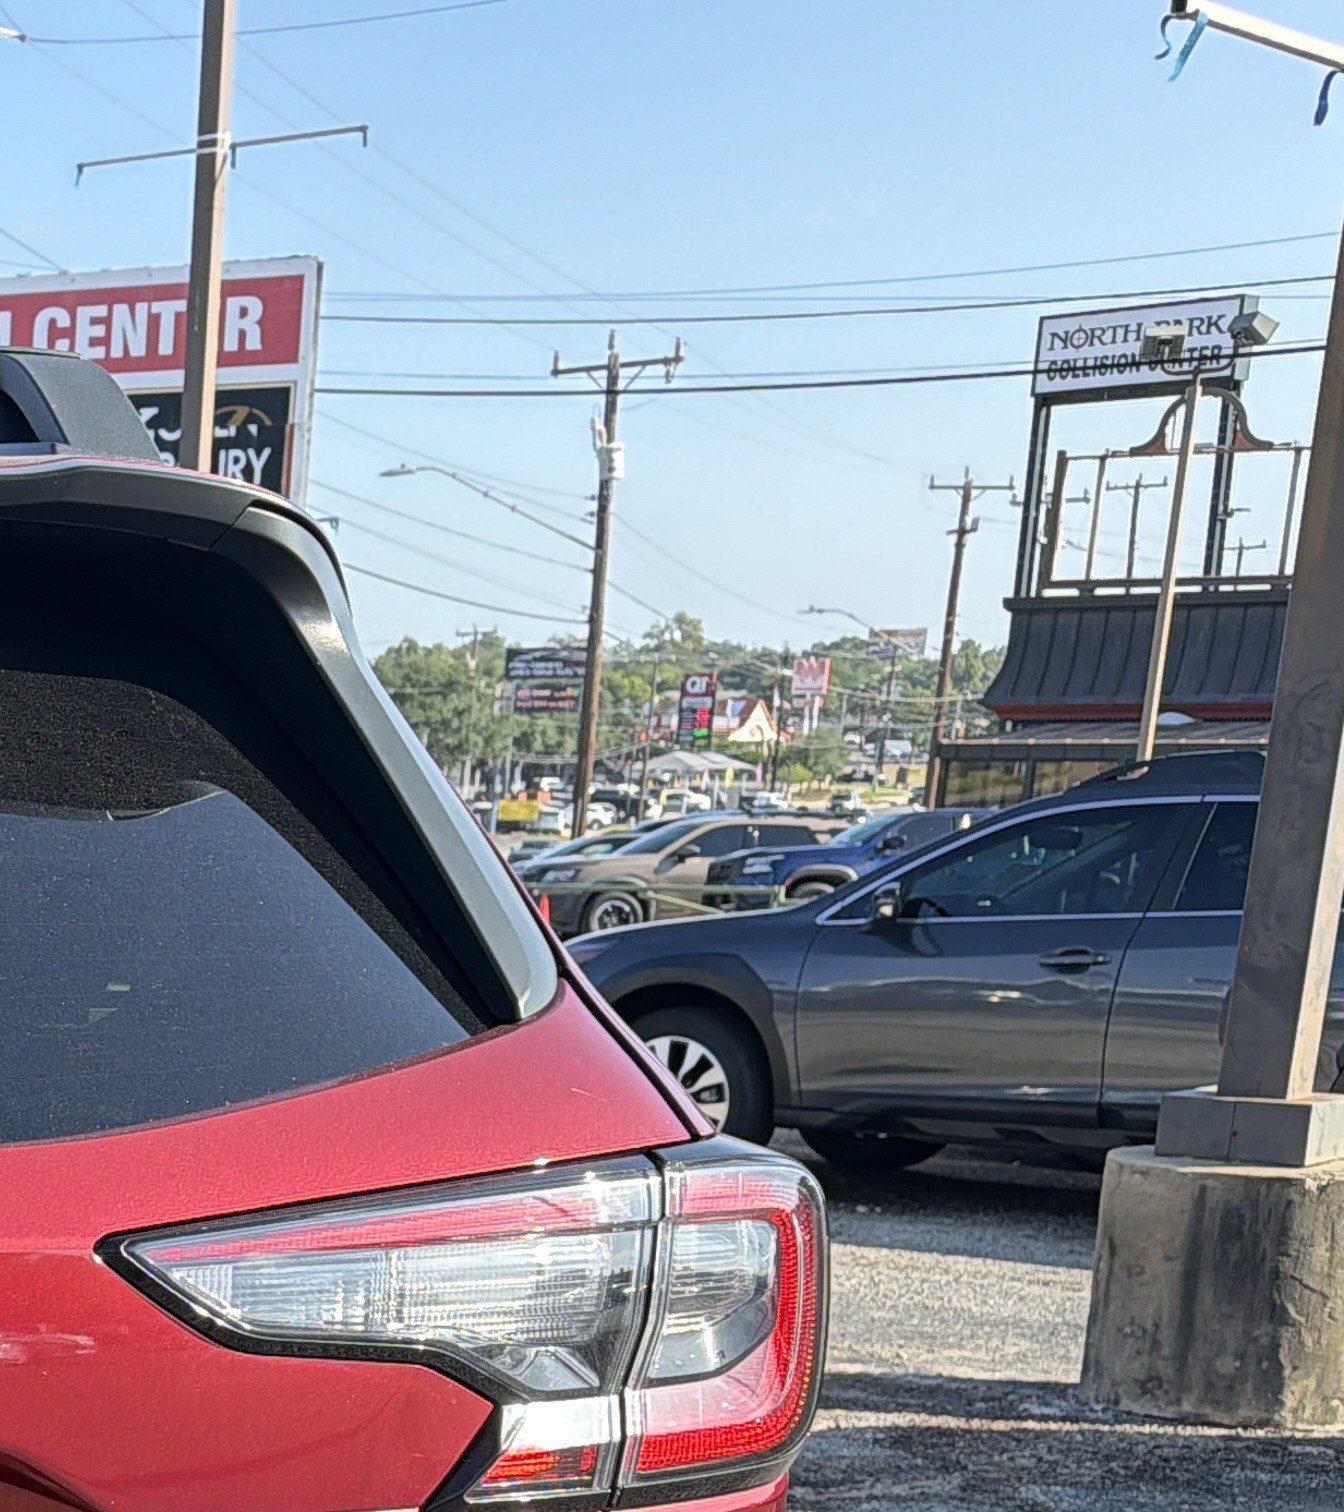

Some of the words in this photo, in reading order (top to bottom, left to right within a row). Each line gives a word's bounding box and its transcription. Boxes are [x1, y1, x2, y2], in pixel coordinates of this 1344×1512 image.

[32, 295, 264, 360] CENTR
[1048, 322, 1143, 351] NORTH
[1155, 313, 1227, 338] RK
